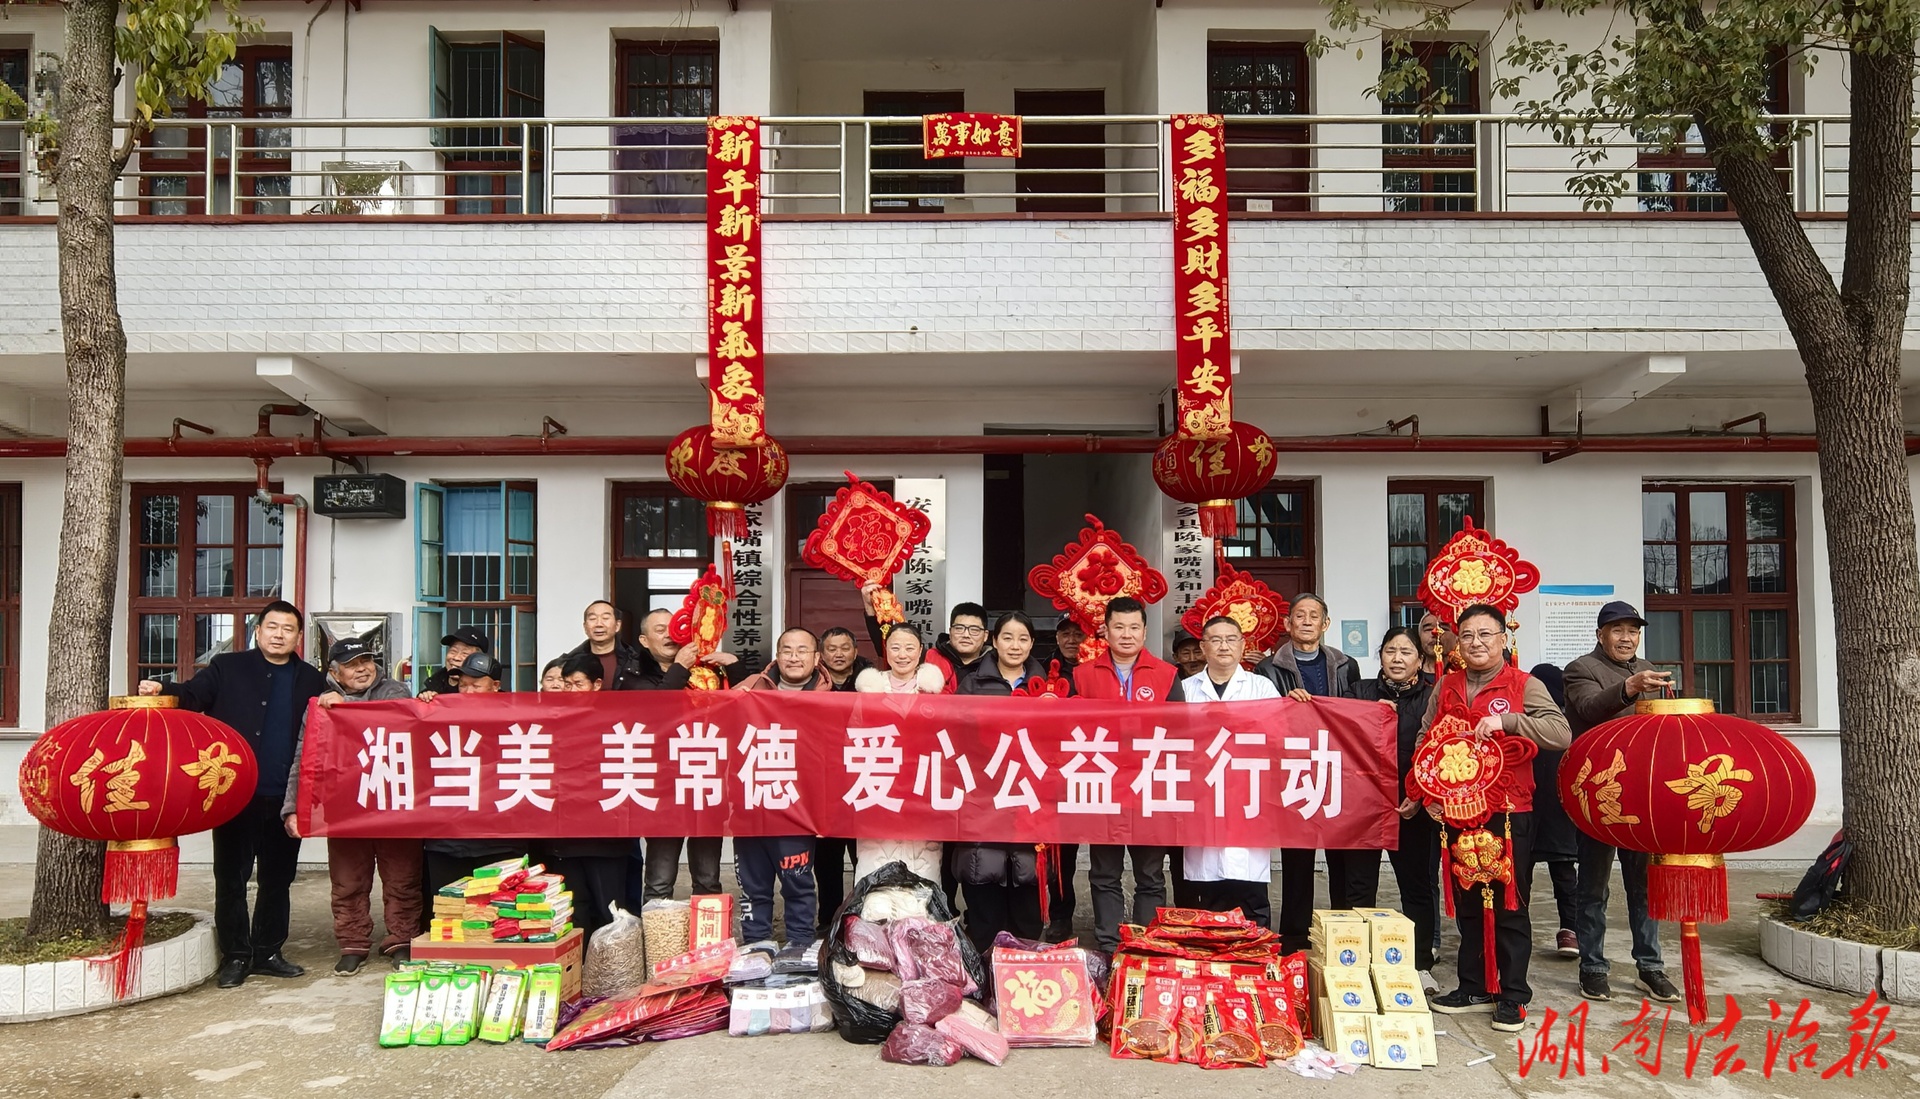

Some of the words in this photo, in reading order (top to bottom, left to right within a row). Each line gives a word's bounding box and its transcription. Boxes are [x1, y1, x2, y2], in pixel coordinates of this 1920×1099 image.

[931, 120, 1015, 146] 萬事如意
[714, 130, 757, 399] 新年新景新氣象
[1179, 129, 1225, 396] 多福多財多平安
[1077, 549, 1125, 596] 福
[1453, 559, 1492, 595] 福
[69, 739, 243, 814] 佳节
[358, 724, 554, 813] 湘当美
[599, 722, 800, 812] 美常德
[843, 724, 1342, 820] 爱心公益在行动
[1438, 741, 1480, 784] 福
[1570, 748, 1755, 834] 佳节
[1003, 969, 1063, 1019] 福
